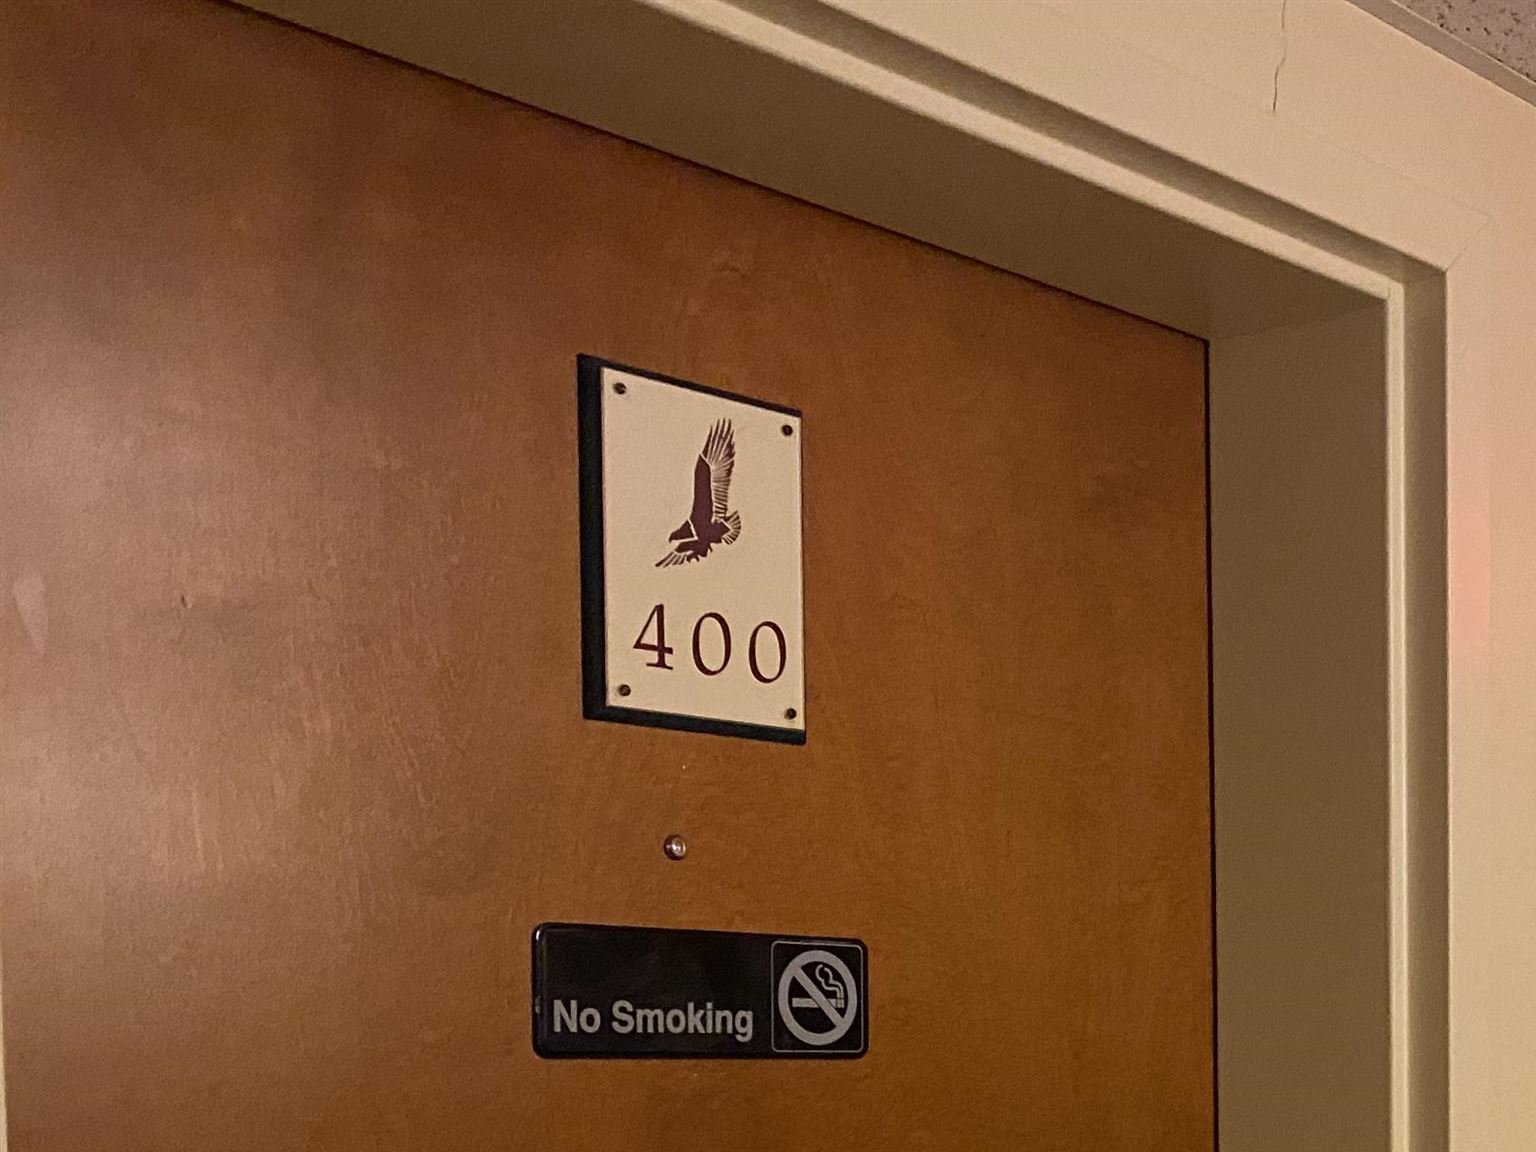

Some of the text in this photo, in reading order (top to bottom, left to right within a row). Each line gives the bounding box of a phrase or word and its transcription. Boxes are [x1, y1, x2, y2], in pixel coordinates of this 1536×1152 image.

[633, 604, 786, 684] 400
[554, 1000, 753, 1043] No Smoking
